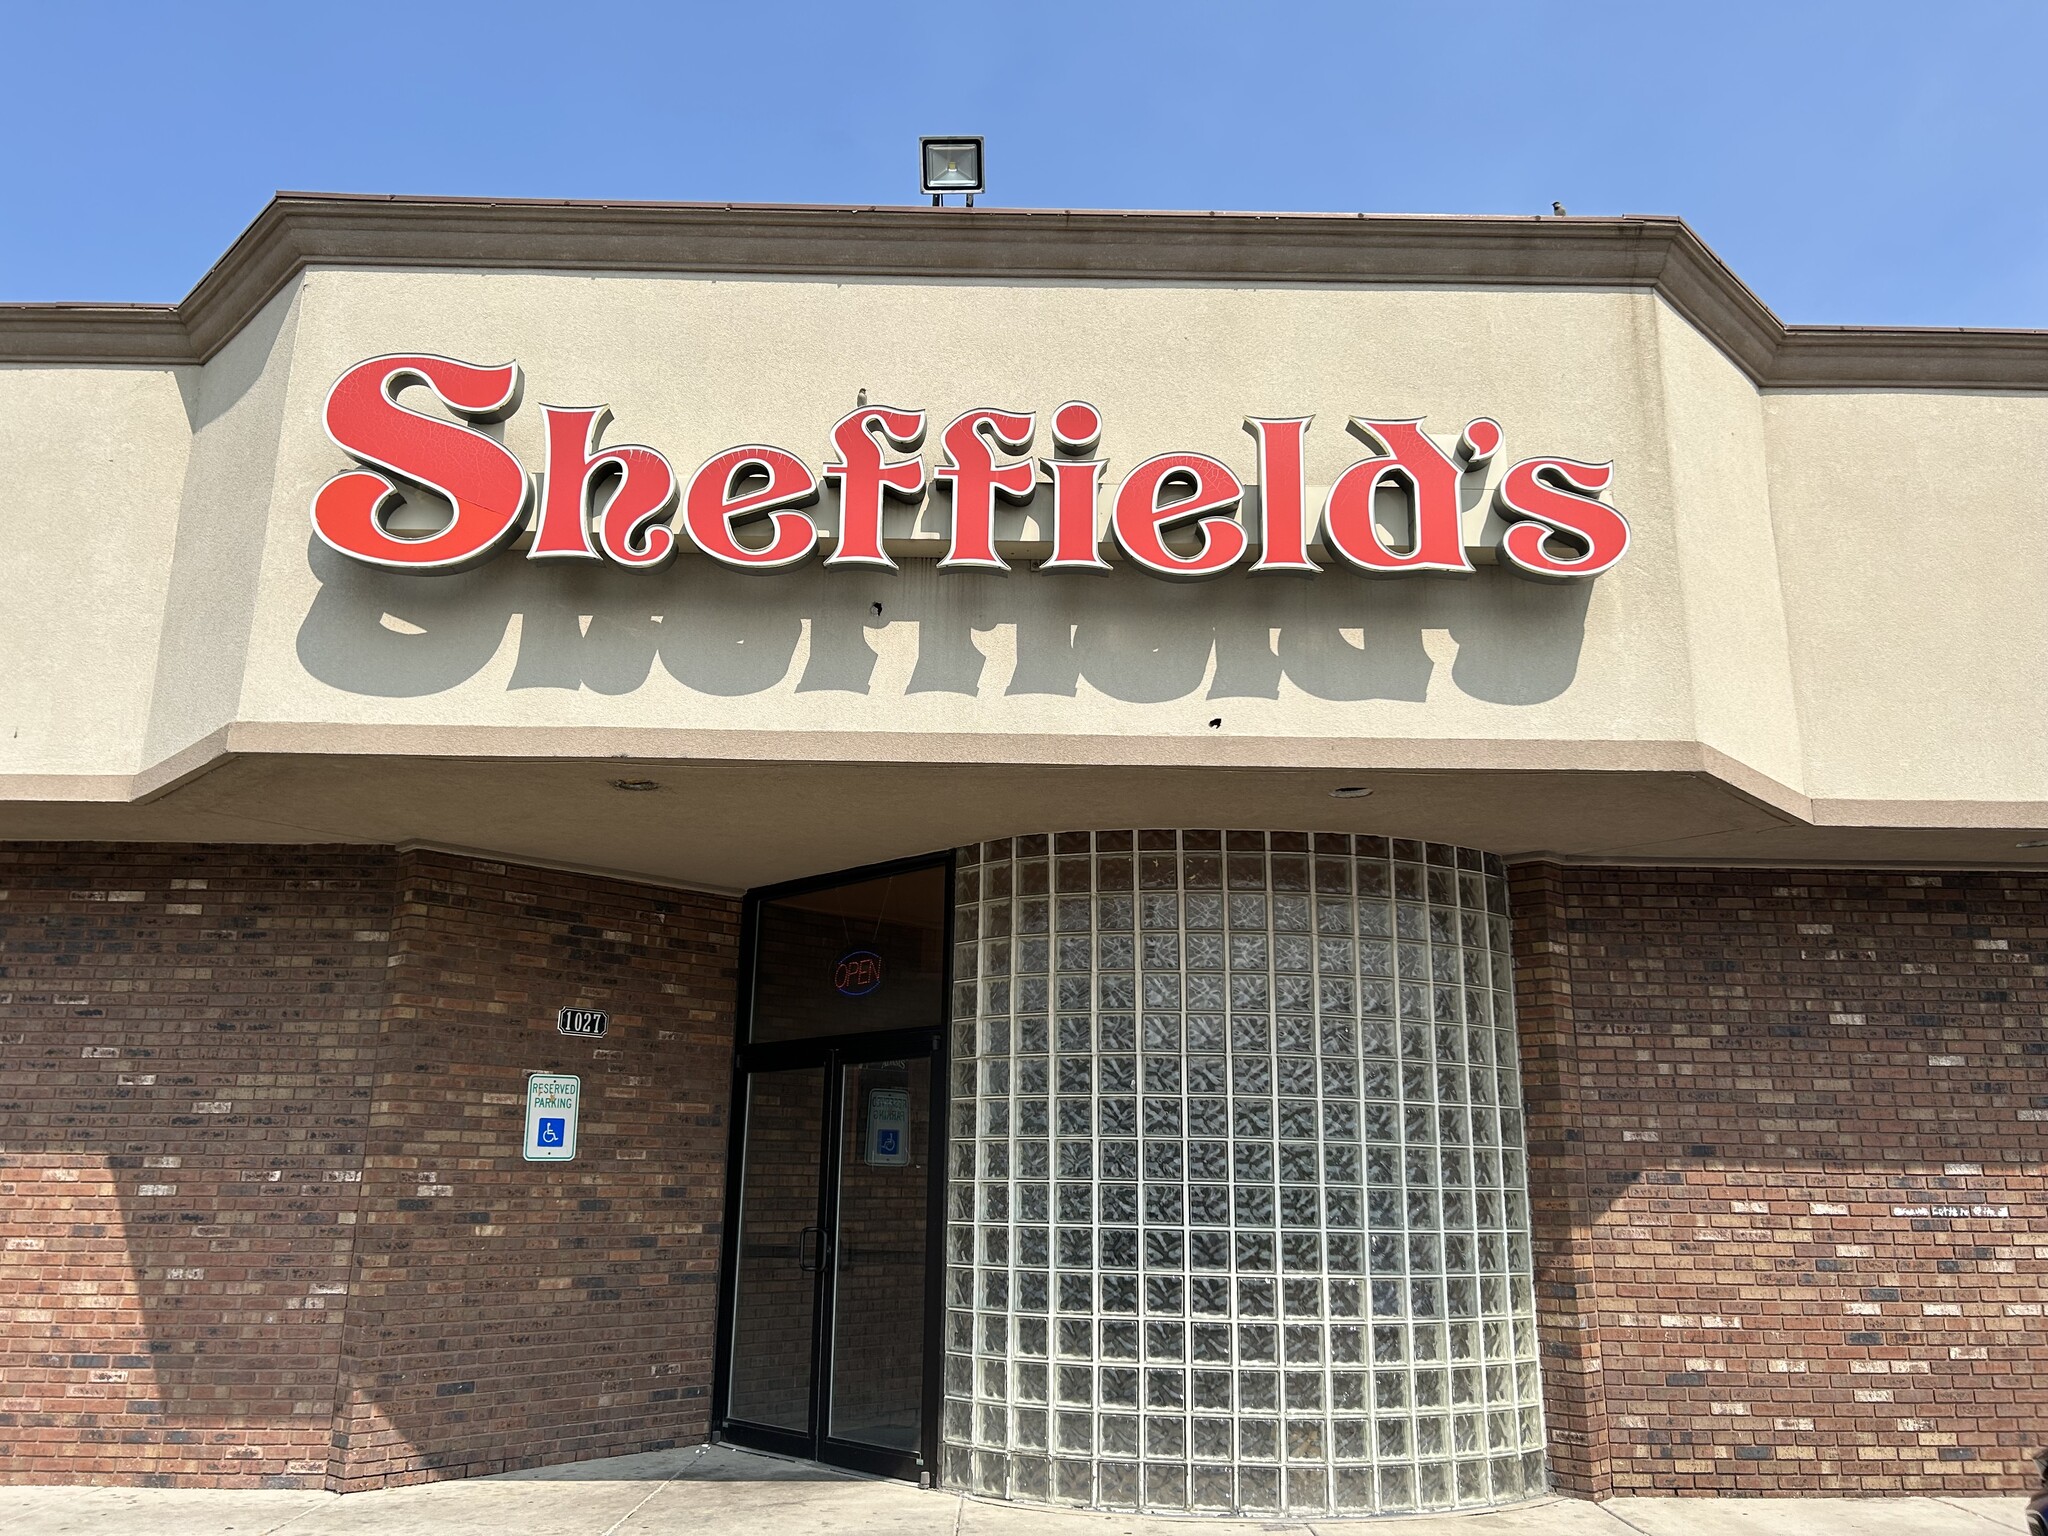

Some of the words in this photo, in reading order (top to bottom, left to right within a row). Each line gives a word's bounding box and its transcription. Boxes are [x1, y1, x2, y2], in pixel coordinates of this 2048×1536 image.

[309, 352, 1632, 580] Sheffield's
[835, 958, 881, 988] OPEN
[565, 1011, 602, 1033] 1027
[532, 1082, 576, 1095] RESERVED
[534, 1098, 572, 1109] PARKING
